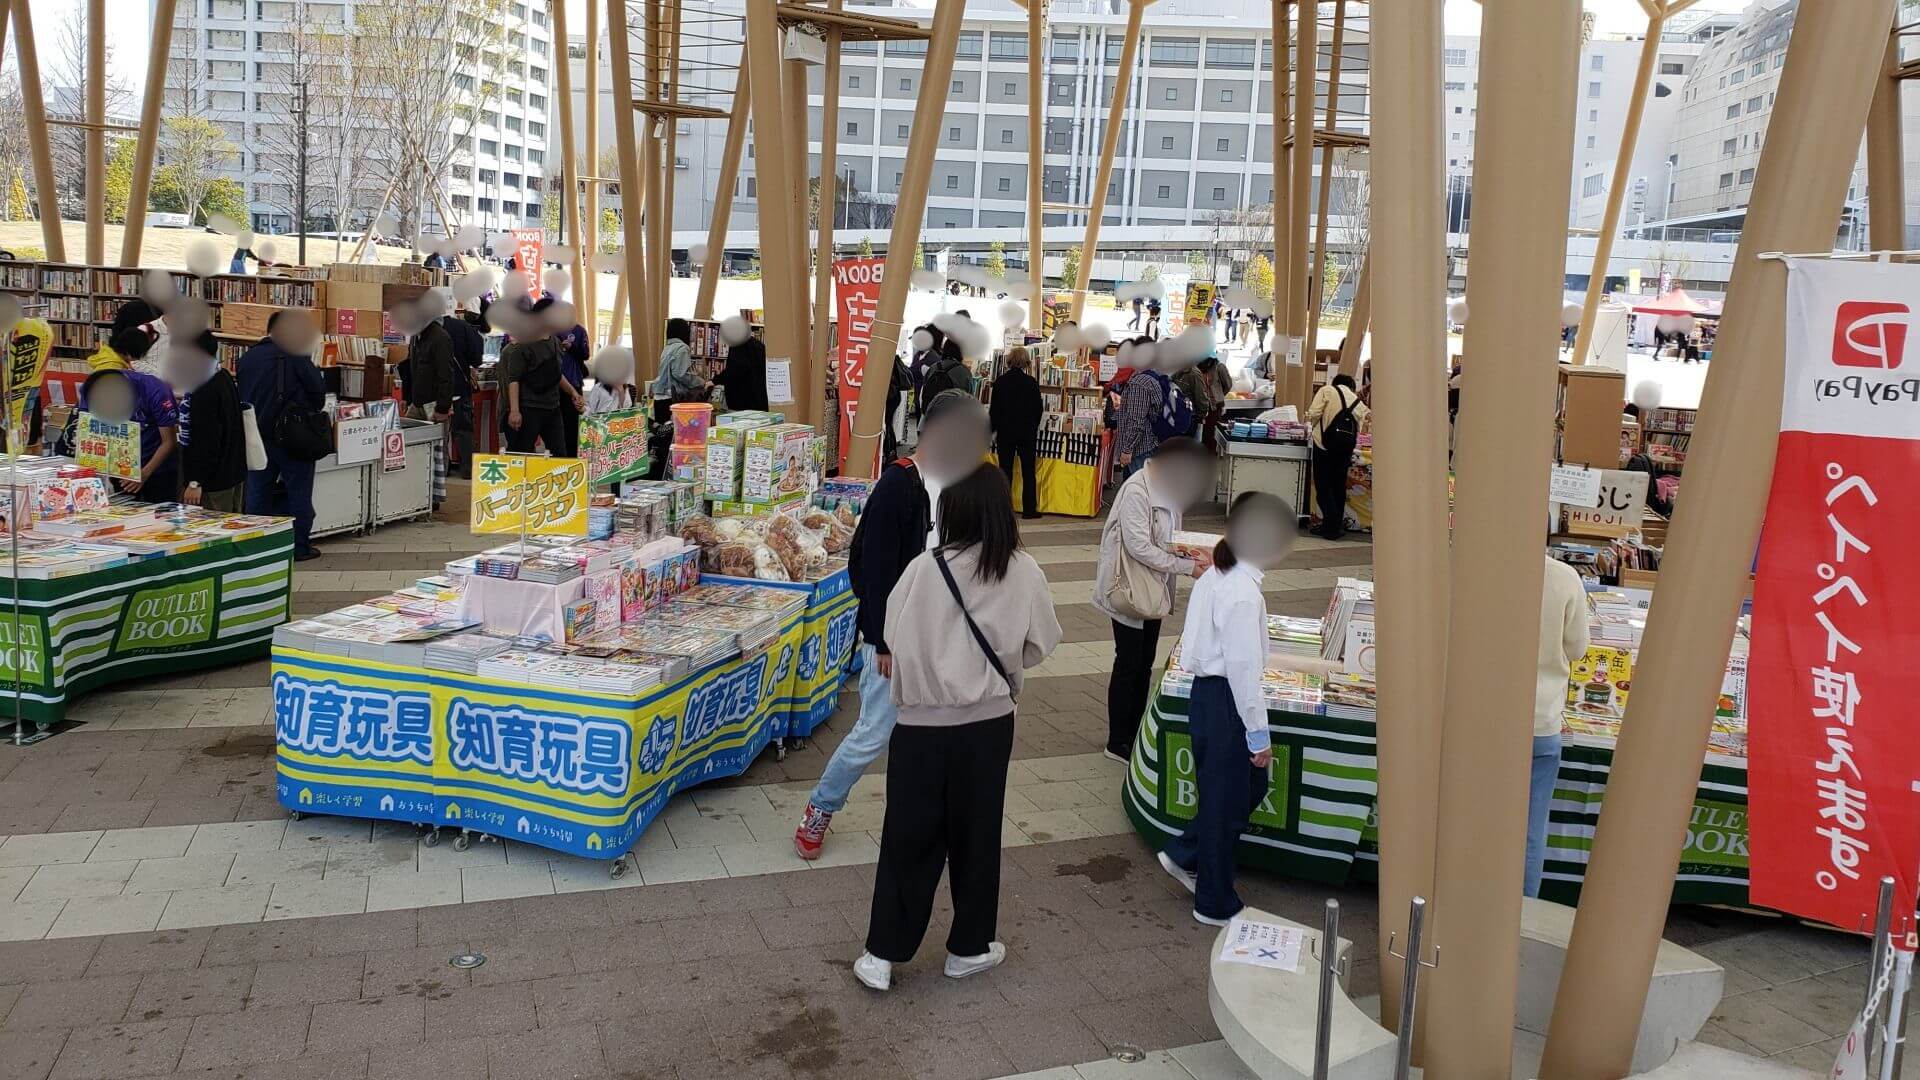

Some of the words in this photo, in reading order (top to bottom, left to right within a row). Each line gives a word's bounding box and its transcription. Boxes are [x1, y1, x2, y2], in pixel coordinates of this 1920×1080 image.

[80, 440, 107, 457] 特価
[361, 436, 379, 446] 広島県
[479, 458, 509, 485] 本
[475, 463, 585, 525] バーゲンブック
[528, 492, 577, 529] フェア
[1561, 510, 1623, 525] SHIOJI
[136, 589, 209, 619] OUTLET
[127, 614, 206, 641] BOOK
[0, 647, 40, 673] OK
[1580, 652, 1625, 668] 水煮缶
[684, 655, 765, 742] 知育玩具
[274, 676, 433, 763] 知育玩具
[454, 701, 628, 796] 知育玩具
[316, 793, 364, 808] 楽しく学習
[464, 807, 505, 827] 楽しく学習
[533, 823, 573, 843] おうち時間
